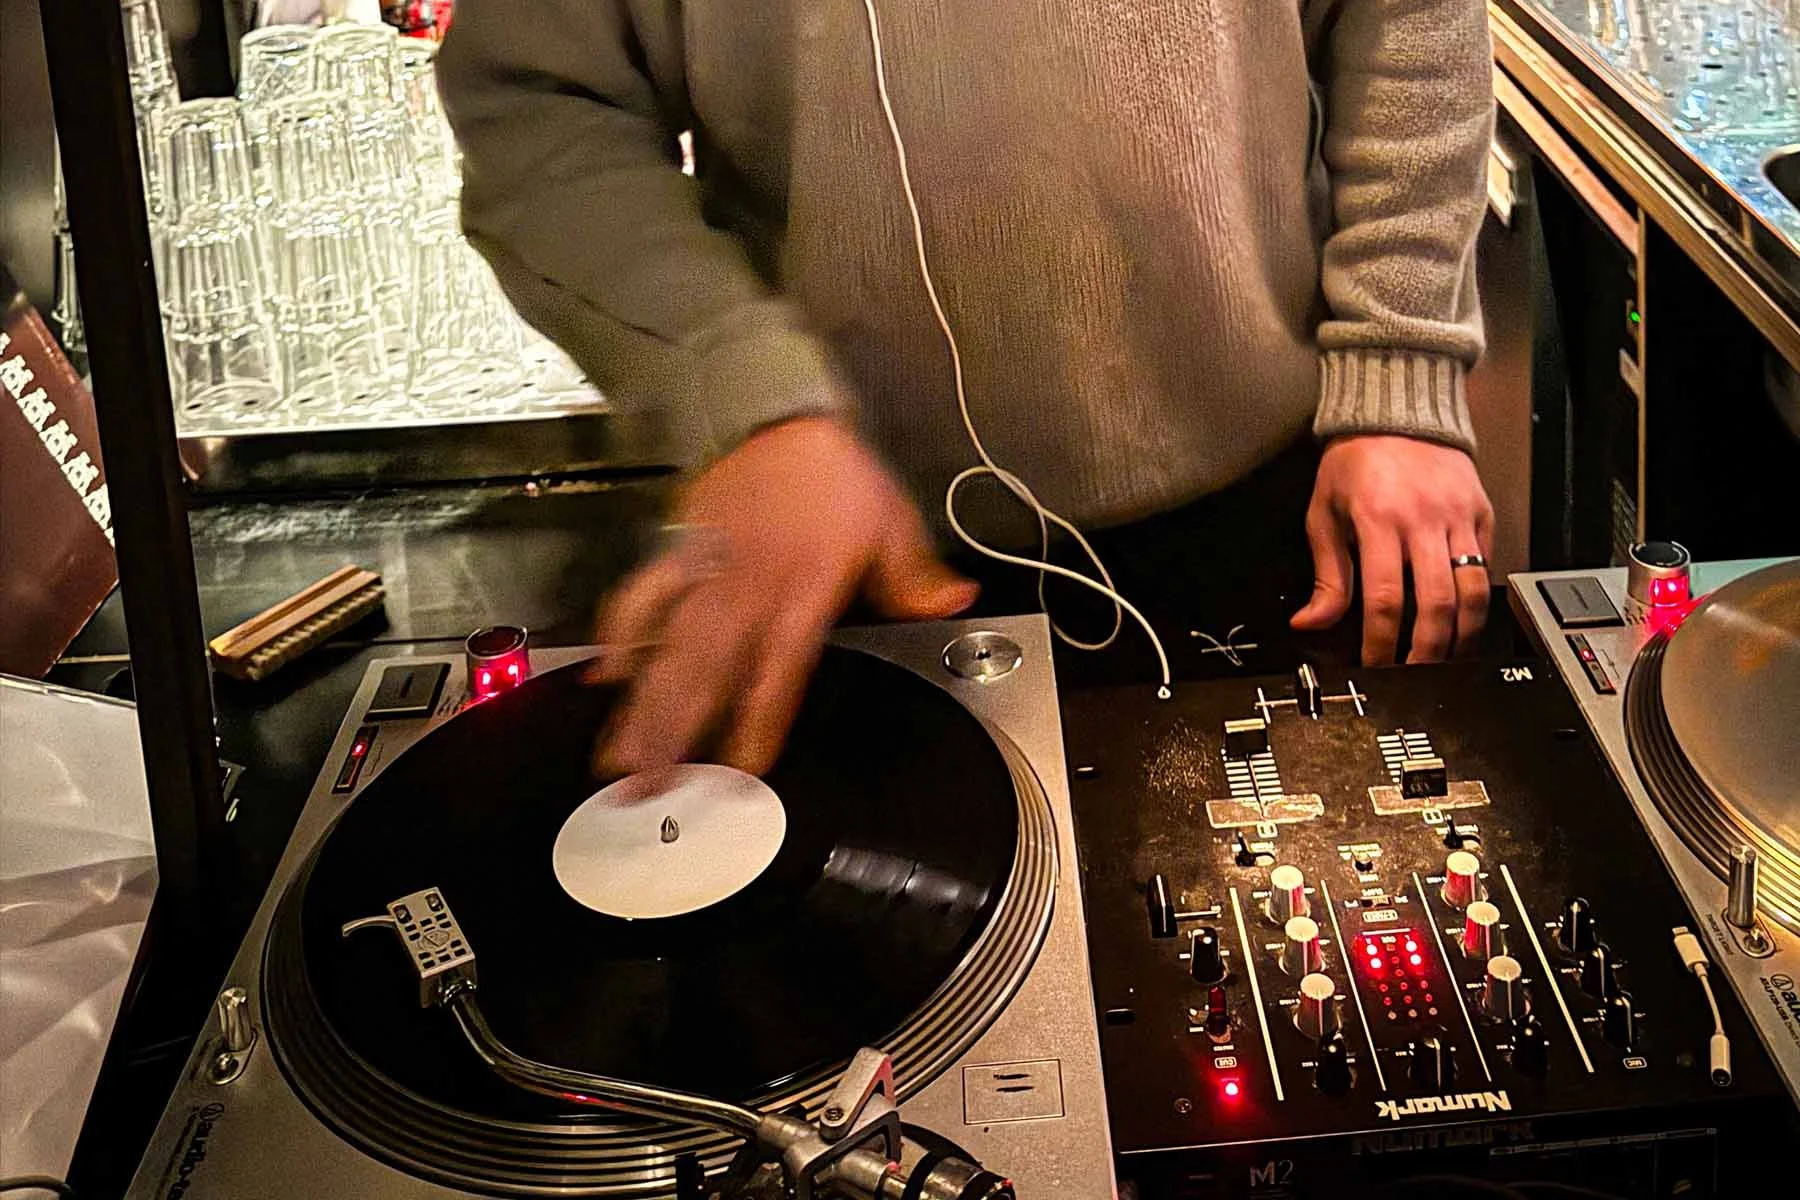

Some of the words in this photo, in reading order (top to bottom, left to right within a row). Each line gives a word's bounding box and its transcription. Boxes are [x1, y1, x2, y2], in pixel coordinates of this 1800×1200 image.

[1500, 666, 1534, 682] M2
[1375, 1091, 1512, 1120] Numark
[1249, 1159, 1295, 1188] M2
